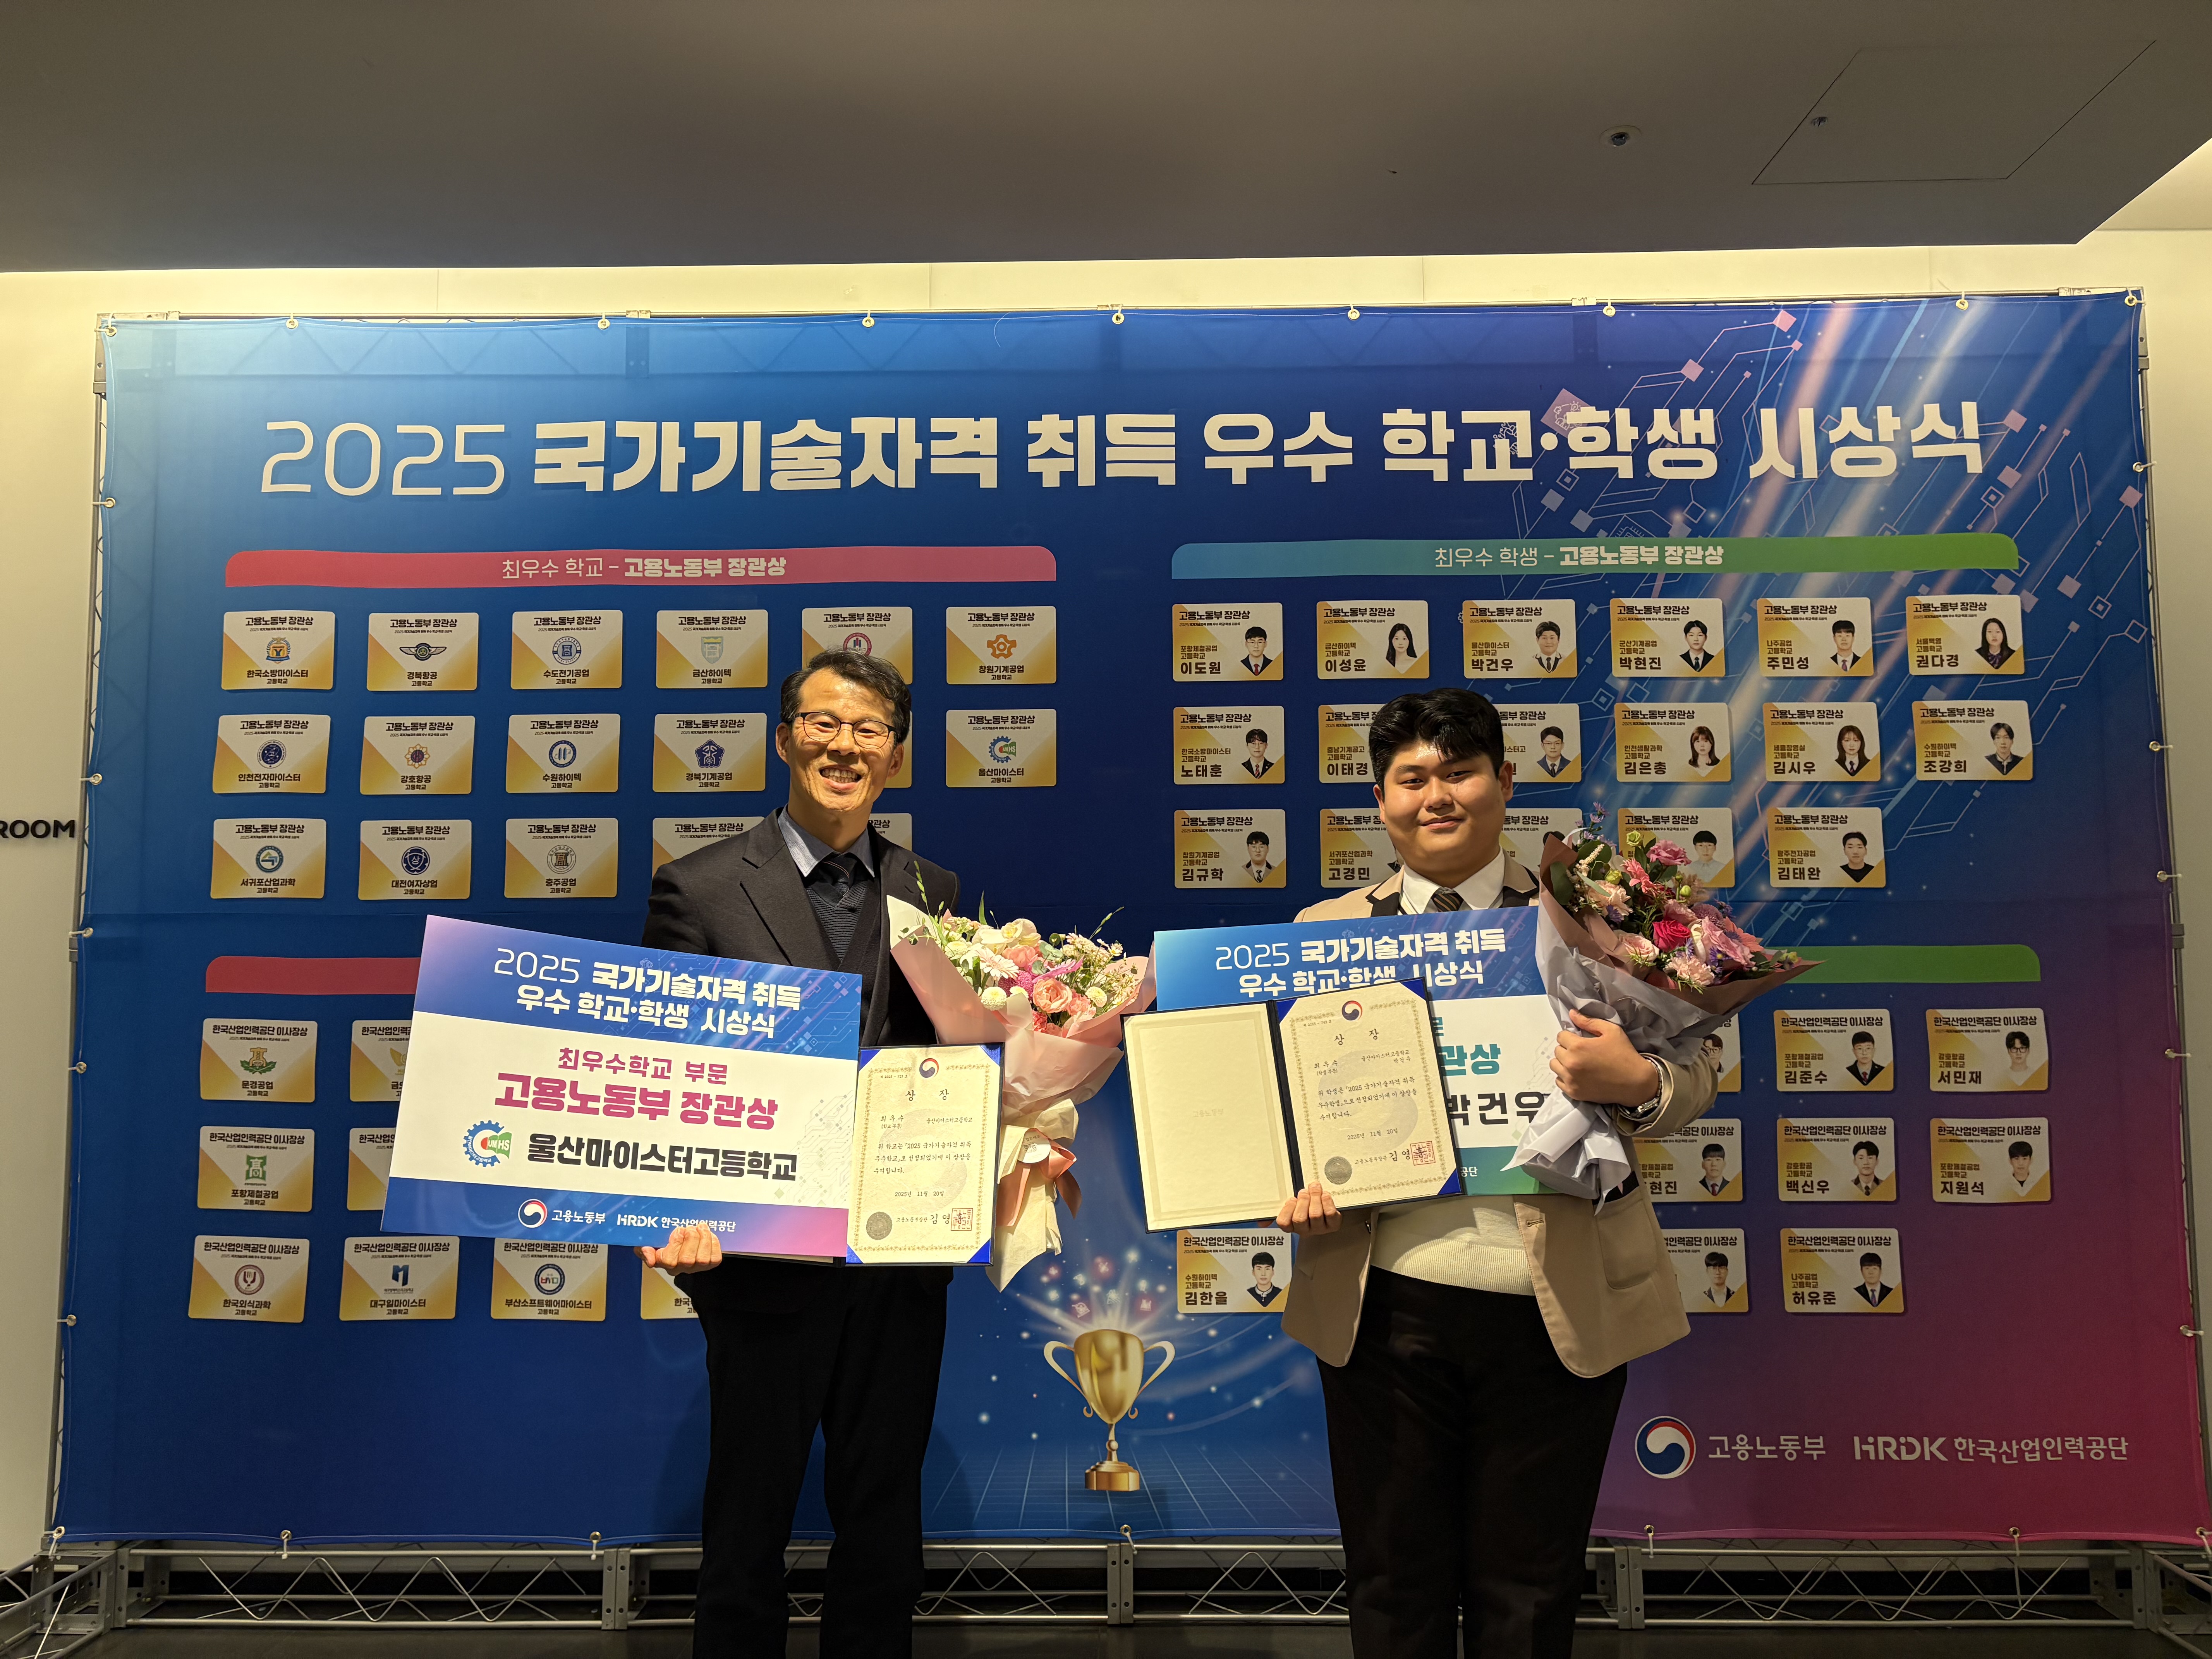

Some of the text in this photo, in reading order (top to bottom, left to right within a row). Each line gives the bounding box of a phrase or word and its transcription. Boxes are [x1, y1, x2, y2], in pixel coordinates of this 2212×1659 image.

[261, 401, 1983, 496] 2025 국가기술자격 취득 우수 학교·학생 시상식
[1434, 546, 1724, 567] 최우수 학생 고용노동부 장관상
[502, 557, 787, 579] 최우수 학교 고용노동부 장관상
[1180, 611, 1250, 620] 고용노동부 장관상
[1470, 607, 1542, 616] 고용노동부 장관상
[1764, 605, 1837, 614] 고용노동부 장관상
[246, 617, 313, 626] 고용노동부 장관상
[390, 619, 457, 627] 고용노동부 장관상
[534, 616, 601, 626] 고용노동부 장관상
[678, 616, 746, 625] 고용노동부 장관상
[968, 613, 1035, 621] 고용노동부 장관상
[1326, 659, 1366, 672] 이성윤
[1472, 659, 1513, 671] 박건우
[1620, 657, 1661, 670] 박현진
[1767, 657, 1808, 670] 주민성
[1916, 654, 1959, 668] 권다경
[247, 669, 308, 678] 한국소방마이스터
[543, 669, 589, 678] 수도전기공업
[1181, 662, 1221, 674] 이도원
[677, 720, 745, 728] 고용노동부 장관상
[968, 716, 1035, 724] 고용노동부 장관상
[1181, 714, 1252, 723] 고용노동부 장관상
[386, 722, 453, 731] 고용노동부 장관상
[1181, 764, 1222, 777] 노태훈
[1327, 763, 1367, 776] 이태경
[1625, 762, 1666, 775] 김은총
[1774, 762, 1815, 774] 김시우
[1924, 760, 1966, 773] 조강희
[238, 773, 301, 781] 인천전자마이스터
[543, 773, 581, 781] 수원하이텍
[686, 773, 732, 781] 경북기계공업
[1182, 817, 1253, 826] 고용노동부 장관상
[1182, 868, 1223, 881] 김규학
[1329, 867, 1370, 880] 고경민
[1778, 867, 1820, 880] 김태완
[546, 878, 576, 886] 충주공업
[1216, 928, 1506, 970] 2025 국가기술자격 취득
[494, 948, 801, 1011] 2025 국가기술자격 취득
[1239, 972, 1286, 998] 우수
[517, 984, 776, 1039] 우수 학교·학생 시상식
[1781, 1017, 1883, 1027] 한국산업인력공단 이사장상
[213, 1025, 308, 1036] 한국산업인력공단 이사장상
[1334, 1029, 1379, 1045] 상 장
[558, 1047, 728, 1085] 최우수학교 부문
[1785, 1071, 1827, 1084] 김준수
[1938, 1071, 1981, 1084] 서민재
[242, 1081, 273, 1089] 문경공업
[495, 1072, 778, 1130] 고용노동부 장관상
[905, 1089, 949, 1101] 상 장
[527, 1133, 797, 1182] 울산마이스터고등학교
[1786, 1180, 1829, 1194] 백신우
[1941, 1181, 1984, 1195] 지원석
[231, 1189, 278, 1199] 포항제철공업
[551, 1210, 605, 1223] 고용노동부
[617, 1214, 659, 1228] HRDK
[354, 1243, 450, 1253] 한국산업인력공단 이사장상
[223, 1299, 271, 1309] 한국외식과학
[370, 1299, 426, 1308] 대구일마이스터
[505, 1299, 592, 1309] 부산소프트웨어마이스터
[1185, 1291, 1227, 1305] 김한을
[1792, 1291, 1836, 1305] 허유준
[1709, 1434, 2129, 1464] 고용노동부 HRDK 한국산업인력공단
